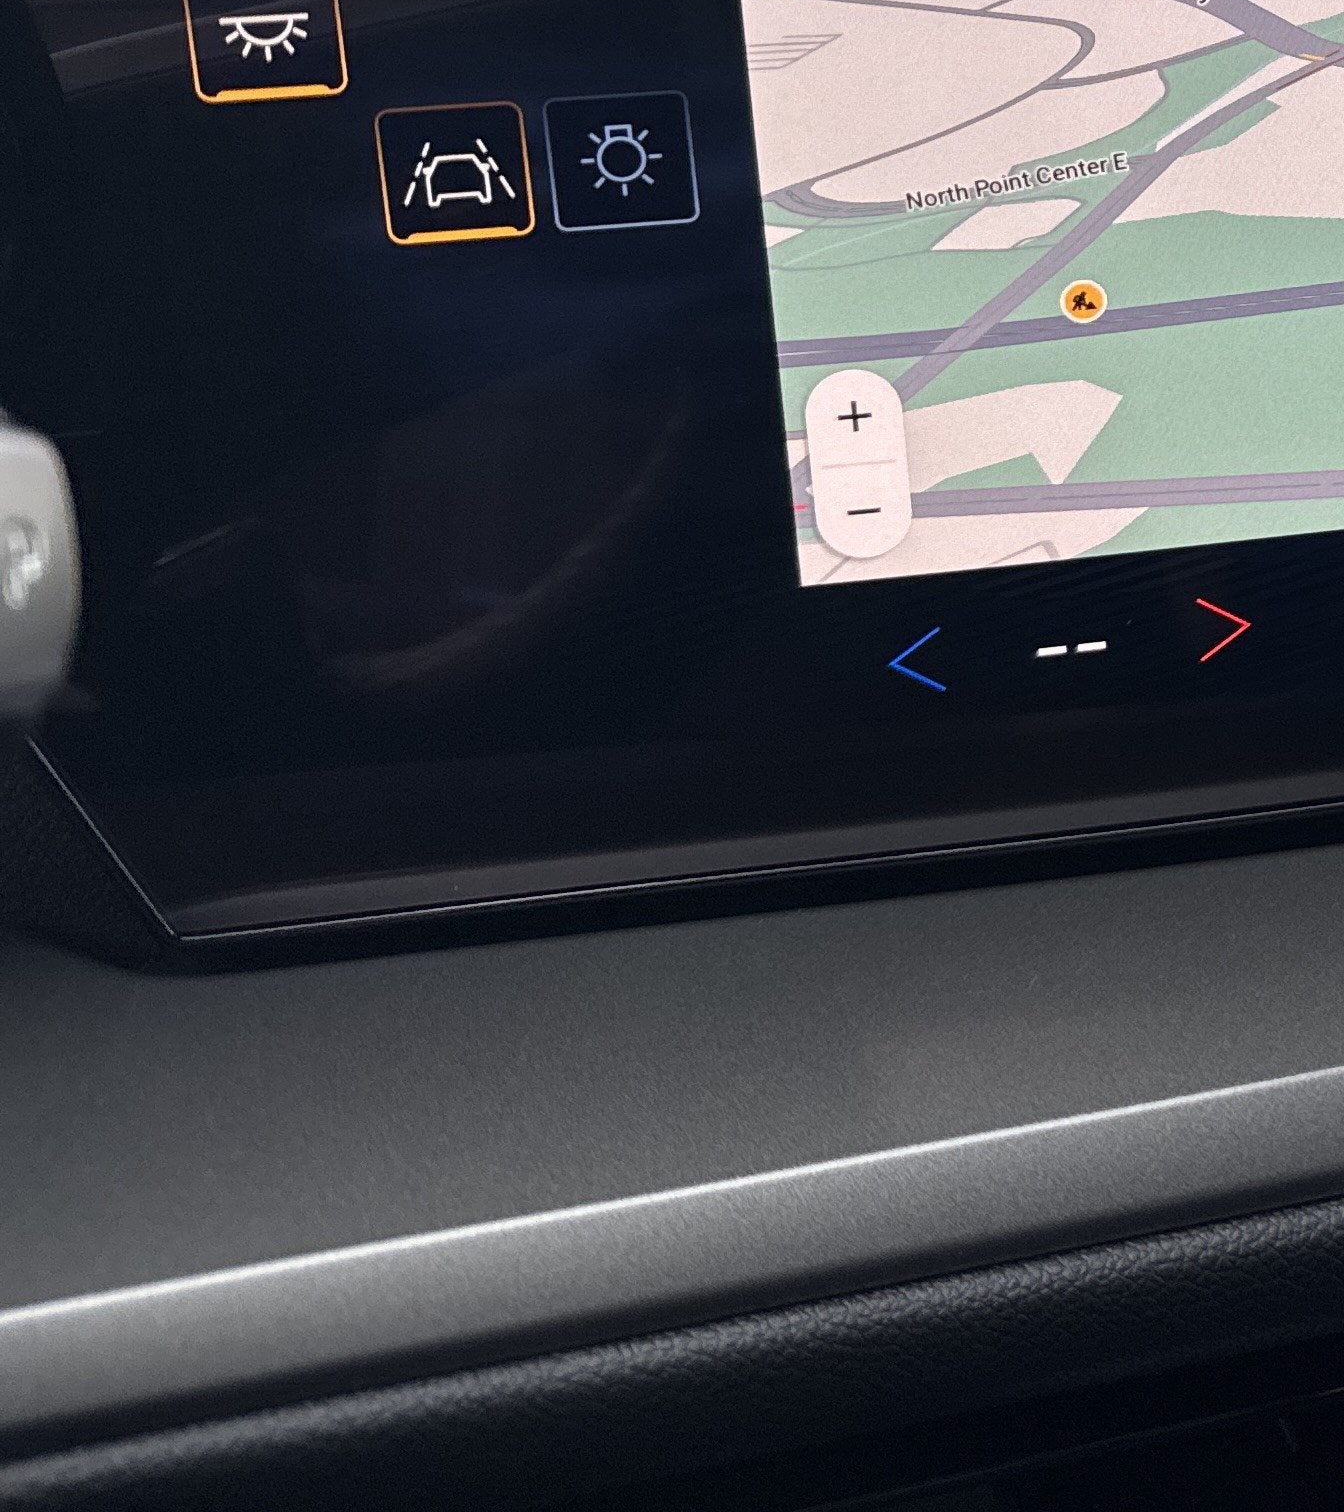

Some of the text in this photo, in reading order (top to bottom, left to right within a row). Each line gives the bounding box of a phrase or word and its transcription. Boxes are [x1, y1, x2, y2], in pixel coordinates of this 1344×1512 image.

[906, 152, 1129, 212] North Point Center E
